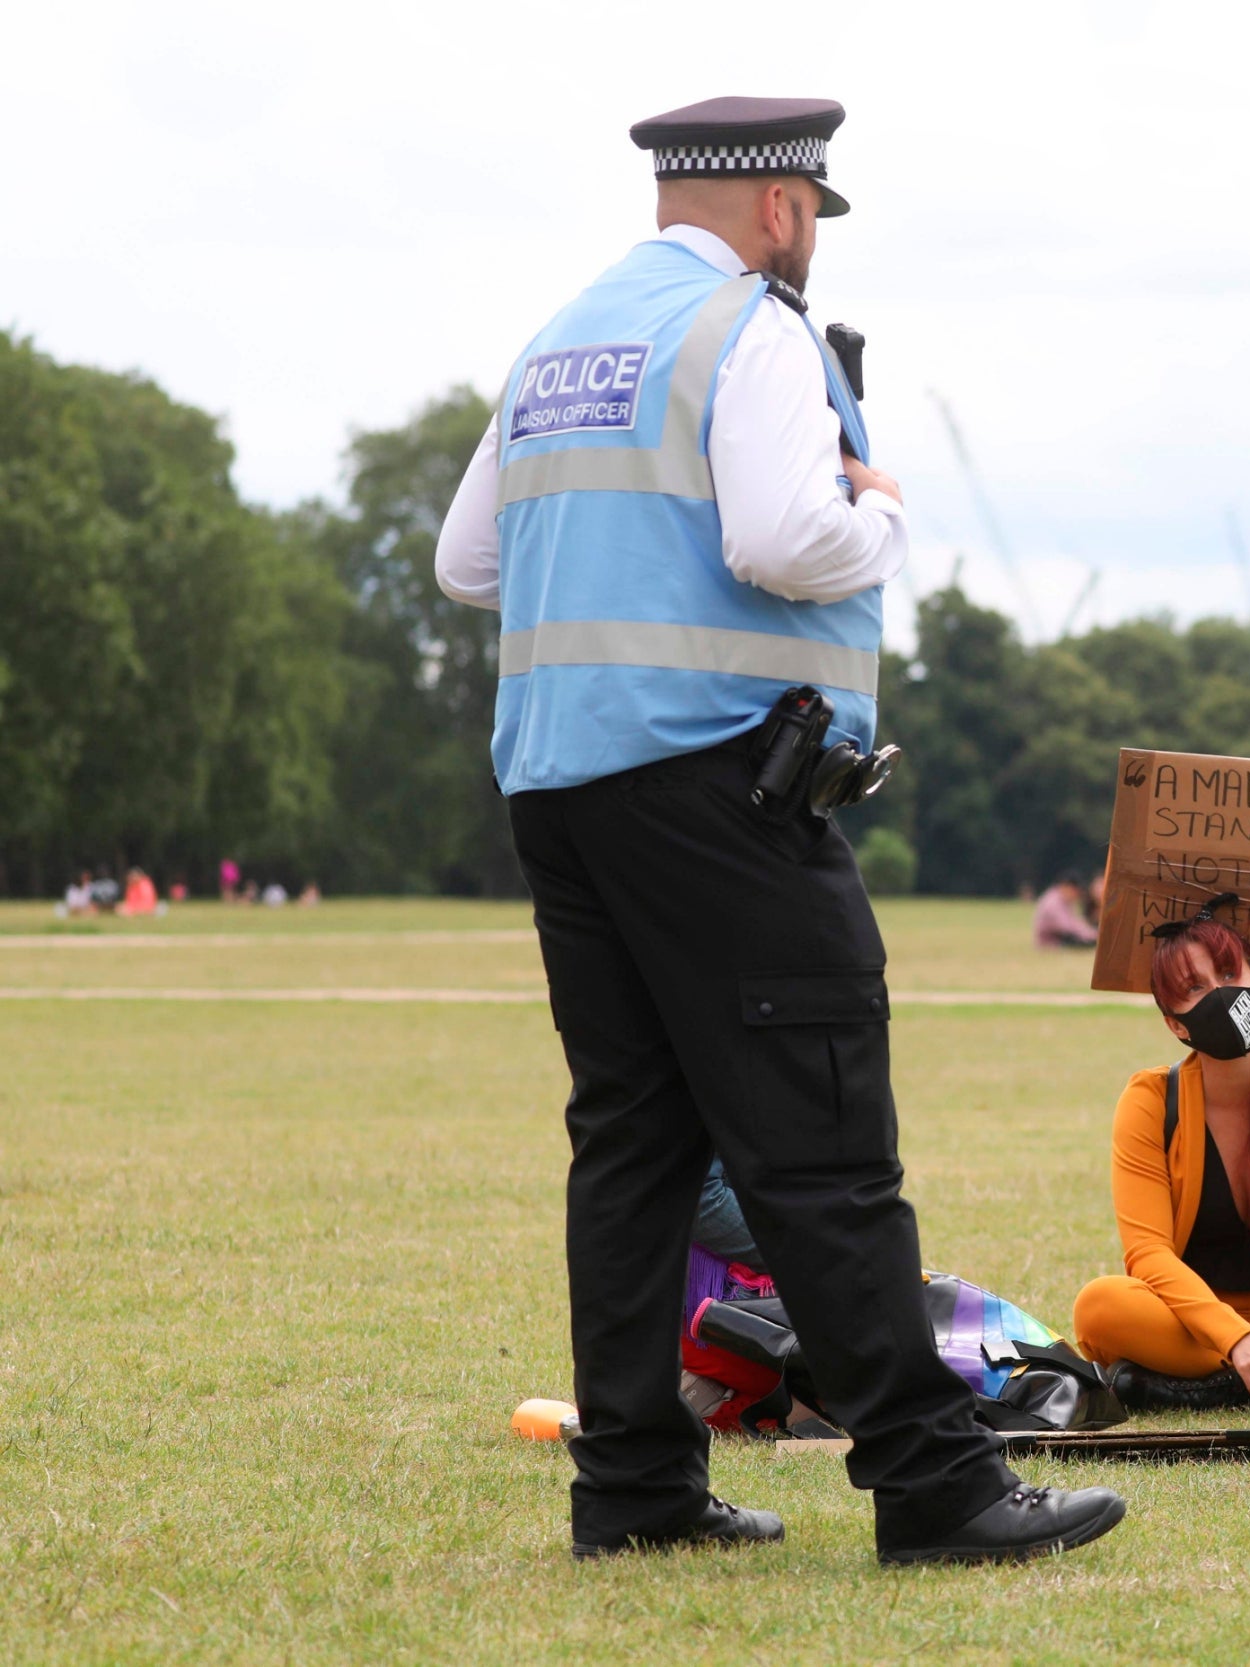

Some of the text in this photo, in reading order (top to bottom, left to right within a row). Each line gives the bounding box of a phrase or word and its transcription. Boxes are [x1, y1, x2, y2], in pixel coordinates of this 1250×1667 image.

[518, 353, 642, 403] POLICE
[512, 402, 630, 434] LIAISON OFFICER
[1142, 889, 1194, 921] WIL
